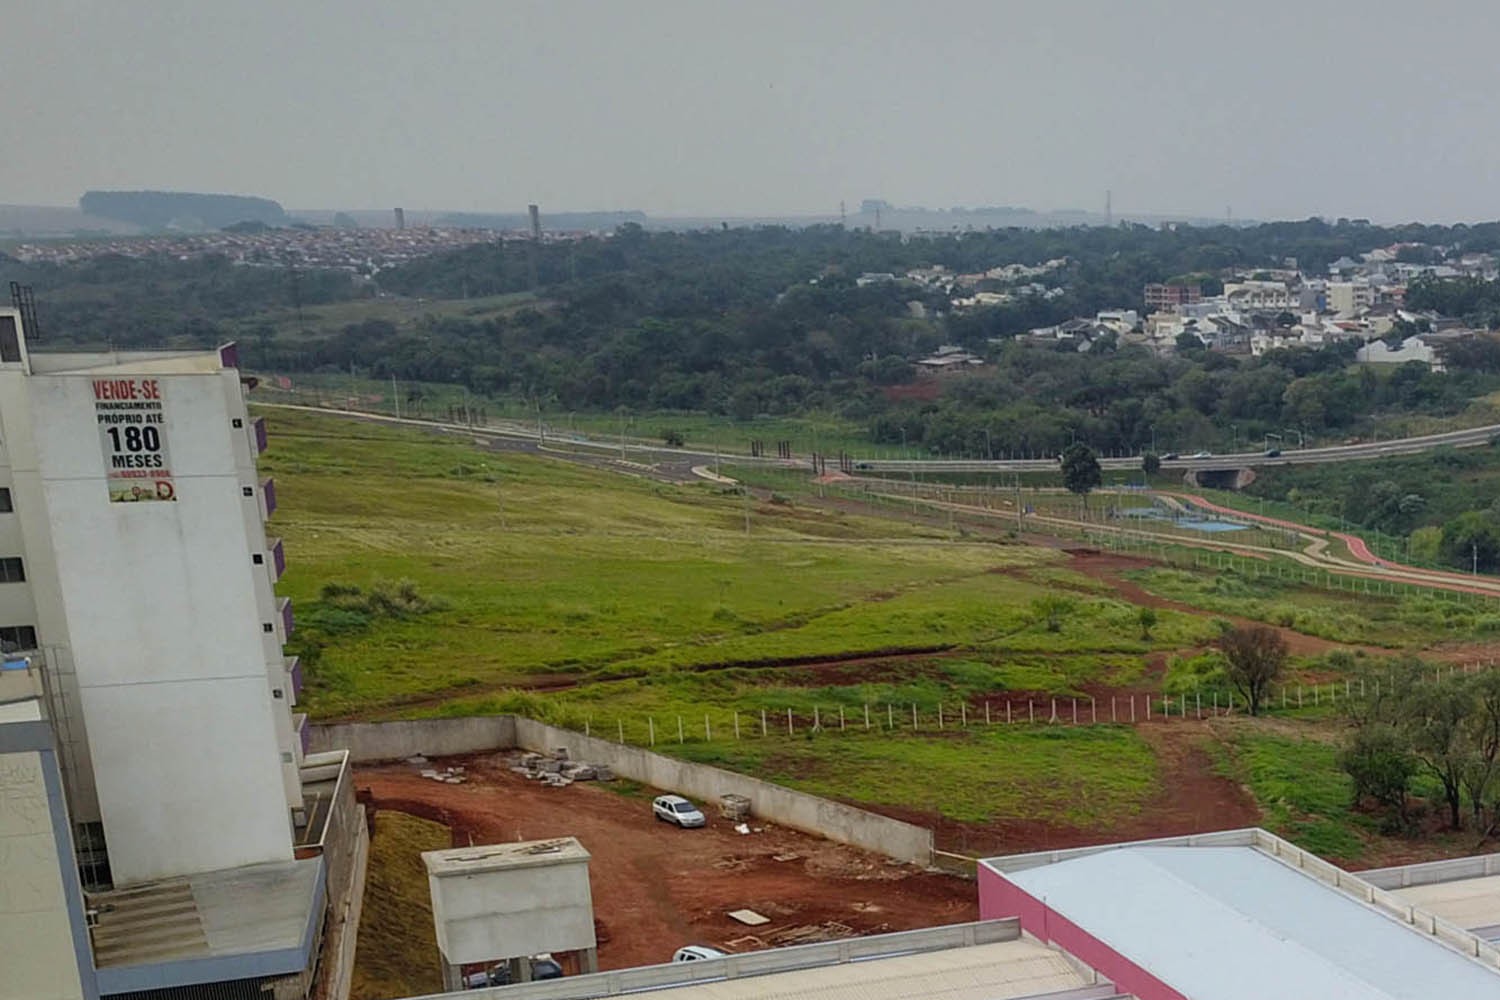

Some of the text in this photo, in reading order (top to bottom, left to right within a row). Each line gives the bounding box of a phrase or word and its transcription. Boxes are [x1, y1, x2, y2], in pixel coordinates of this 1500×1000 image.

[92, 380, 161, 400] VENDE-SE
[95, 402, 162, 410] FINANCIAMENTO
[106, 425, 161, 452] 180
[112, 454, 163, 468] MESES
